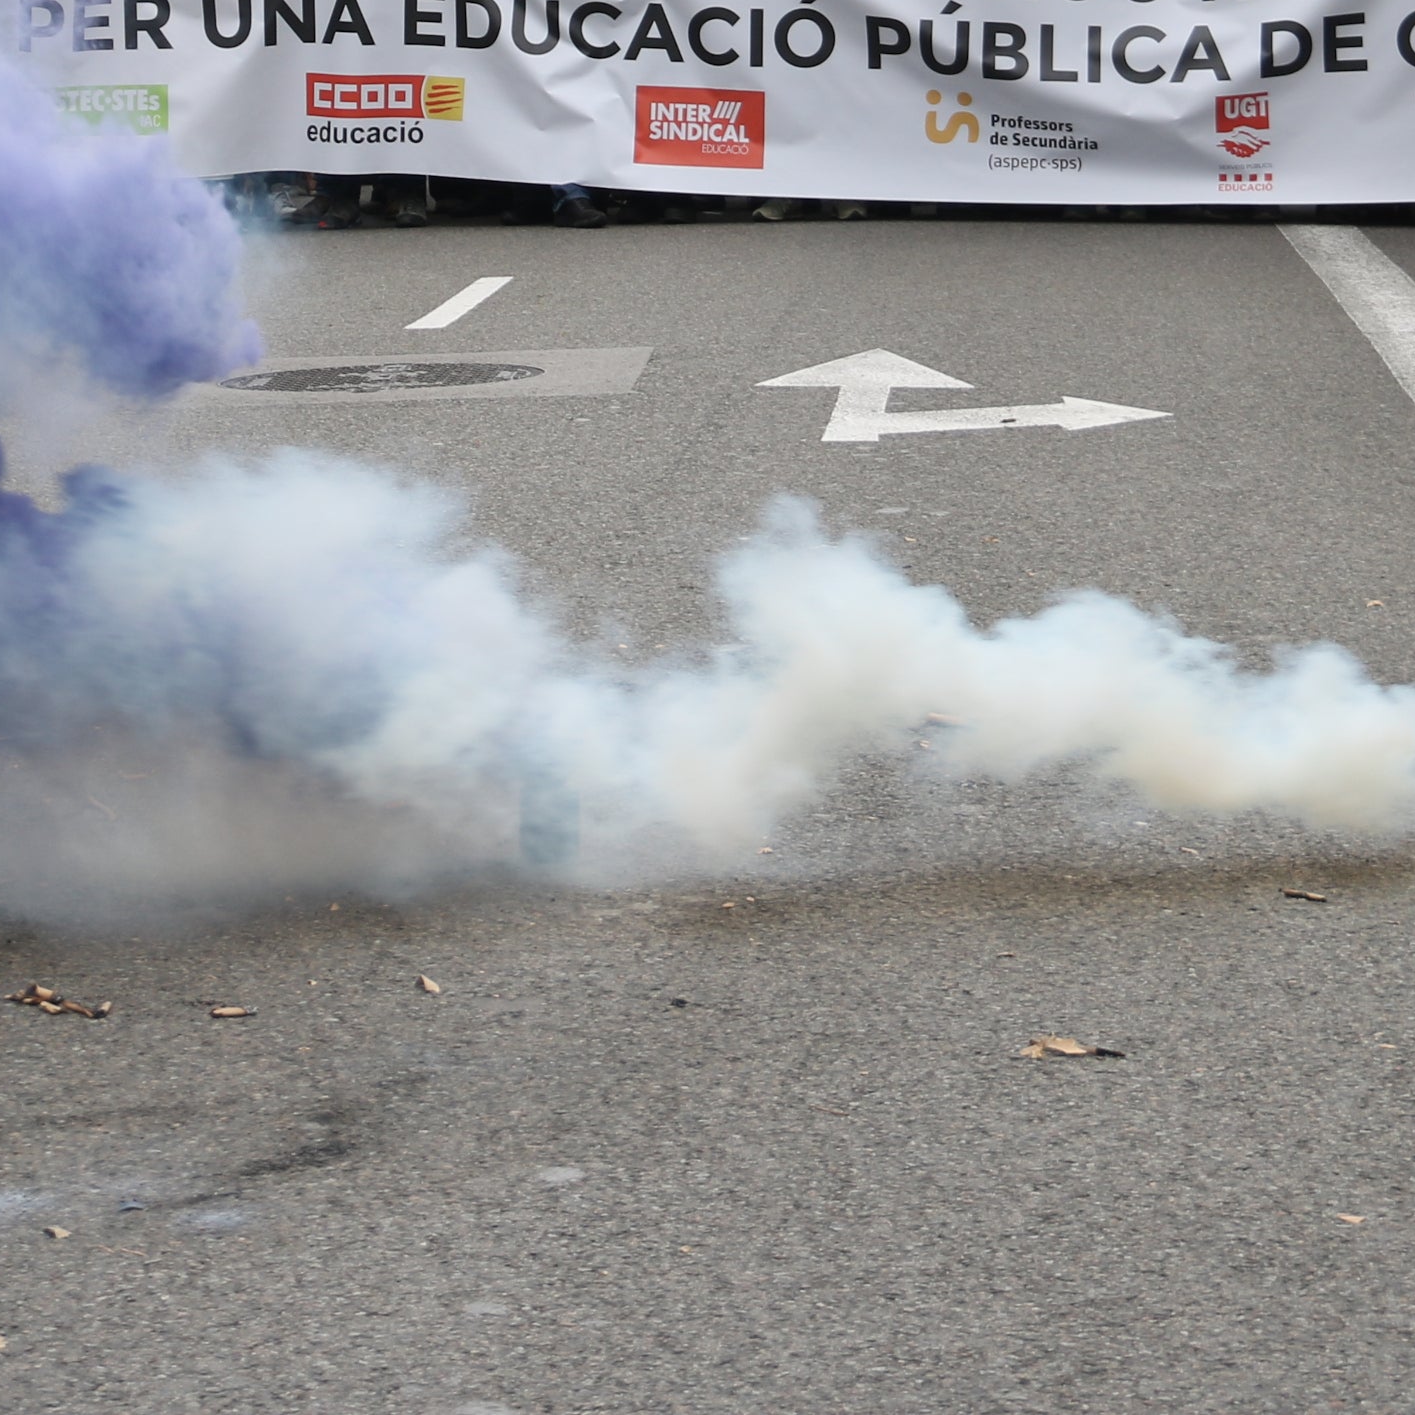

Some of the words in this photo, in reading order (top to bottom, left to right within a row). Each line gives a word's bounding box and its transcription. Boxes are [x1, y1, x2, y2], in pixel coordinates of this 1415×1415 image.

[865, 0, 1232, 83] PÚBLICA
[1260, 12, 1368, 79] DE
[55, 89, 161, 112] STEC·STEs
[313, 81, 413, 110] CCOO
[1224, 95, 1268, 119] UGT
[650, 102, 712, 123] INTER
[991, 114, 1073, 133] Professors
[306, 120, 425, 145] educació
[649, 121, 750, 144] SINDICAL
[989, 132, 1009, 147] de
[1012, 132, 1099, 151] Secundària
[701, 143, 750, 156] EDUCACIÓ
[1218, 182, 1274, 192] EDUCACIÓ
